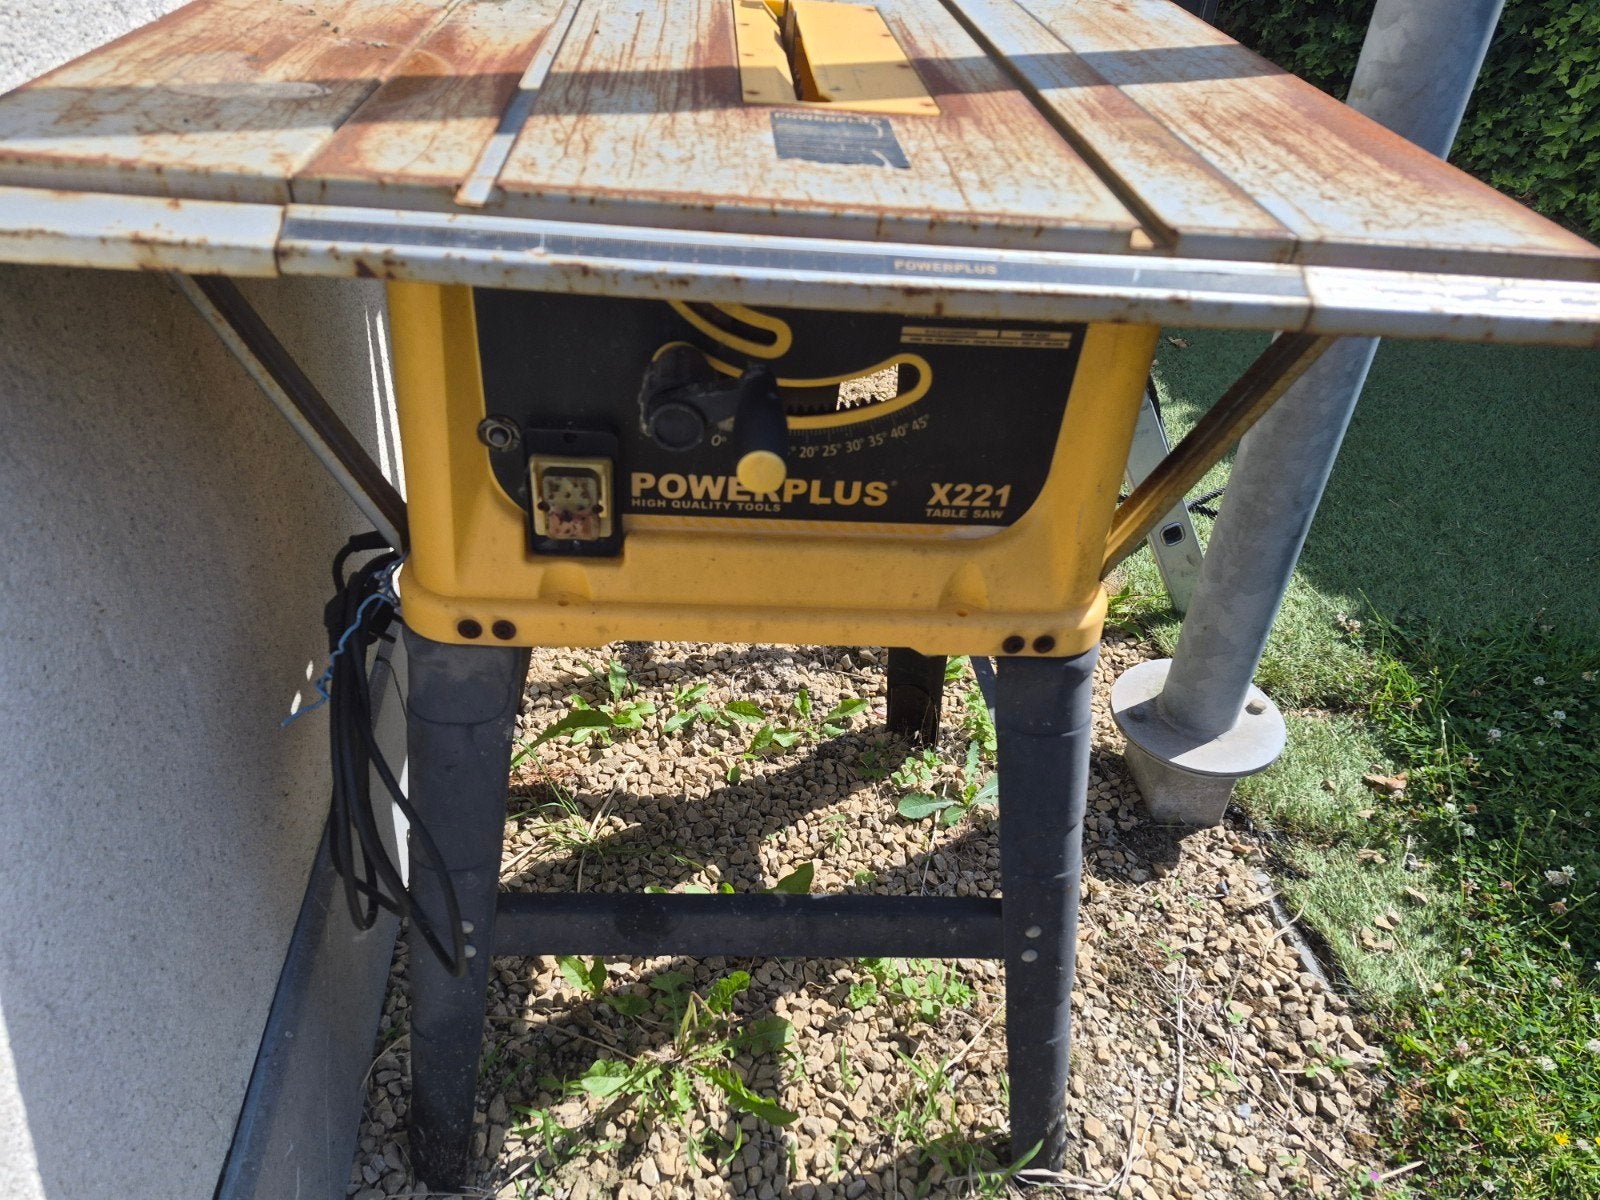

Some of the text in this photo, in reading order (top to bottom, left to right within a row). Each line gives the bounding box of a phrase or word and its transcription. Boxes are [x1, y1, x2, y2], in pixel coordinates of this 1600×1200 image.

[894, 259, 998, 275] POWERPLUS
[926, 482, 1012, 507] X221
[631, 498, 781, 512] HIGH QUALITY TOOLS
[925, 508, 1004, 519] TABLE SAW
